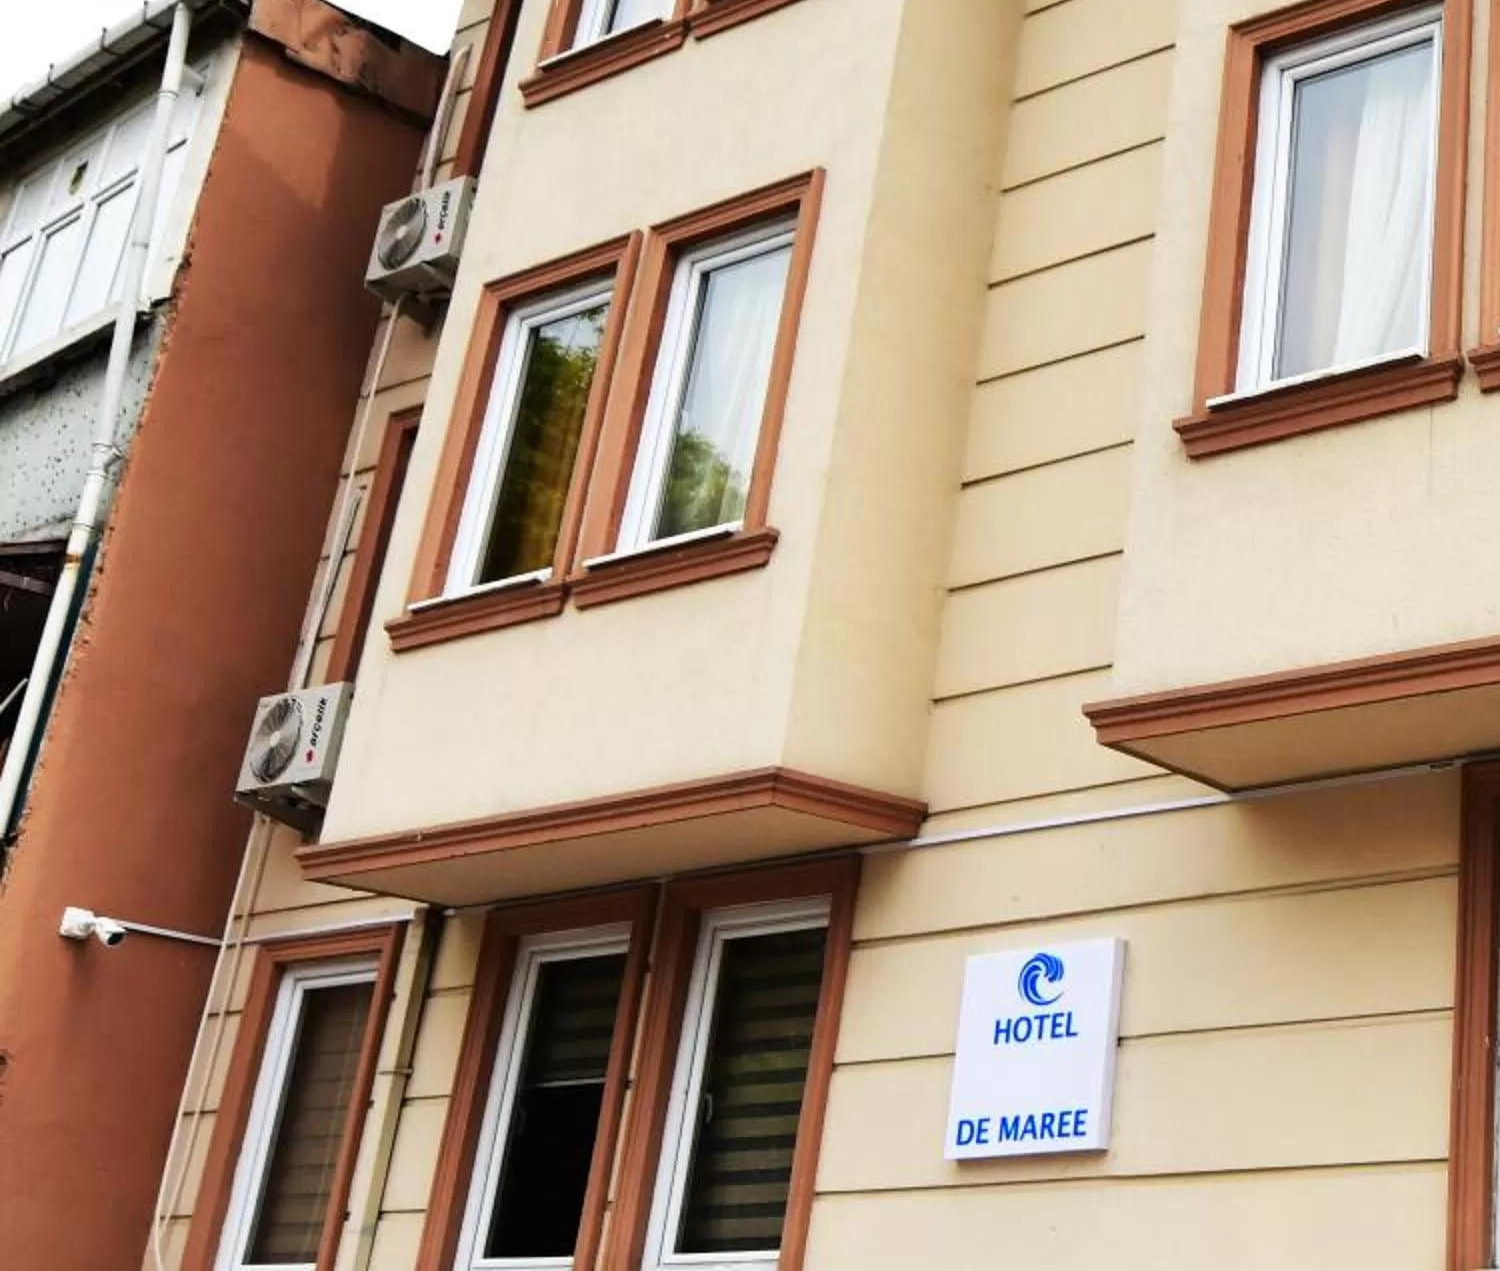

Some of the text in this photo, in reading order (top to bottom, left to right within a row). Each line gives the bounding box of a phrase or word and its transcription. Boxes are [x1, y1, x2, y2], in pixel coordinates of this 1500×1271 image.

[993, 1011, 1078, 1045] HOTEL
[955, 1108, 1089, 1146] DE MAREE
